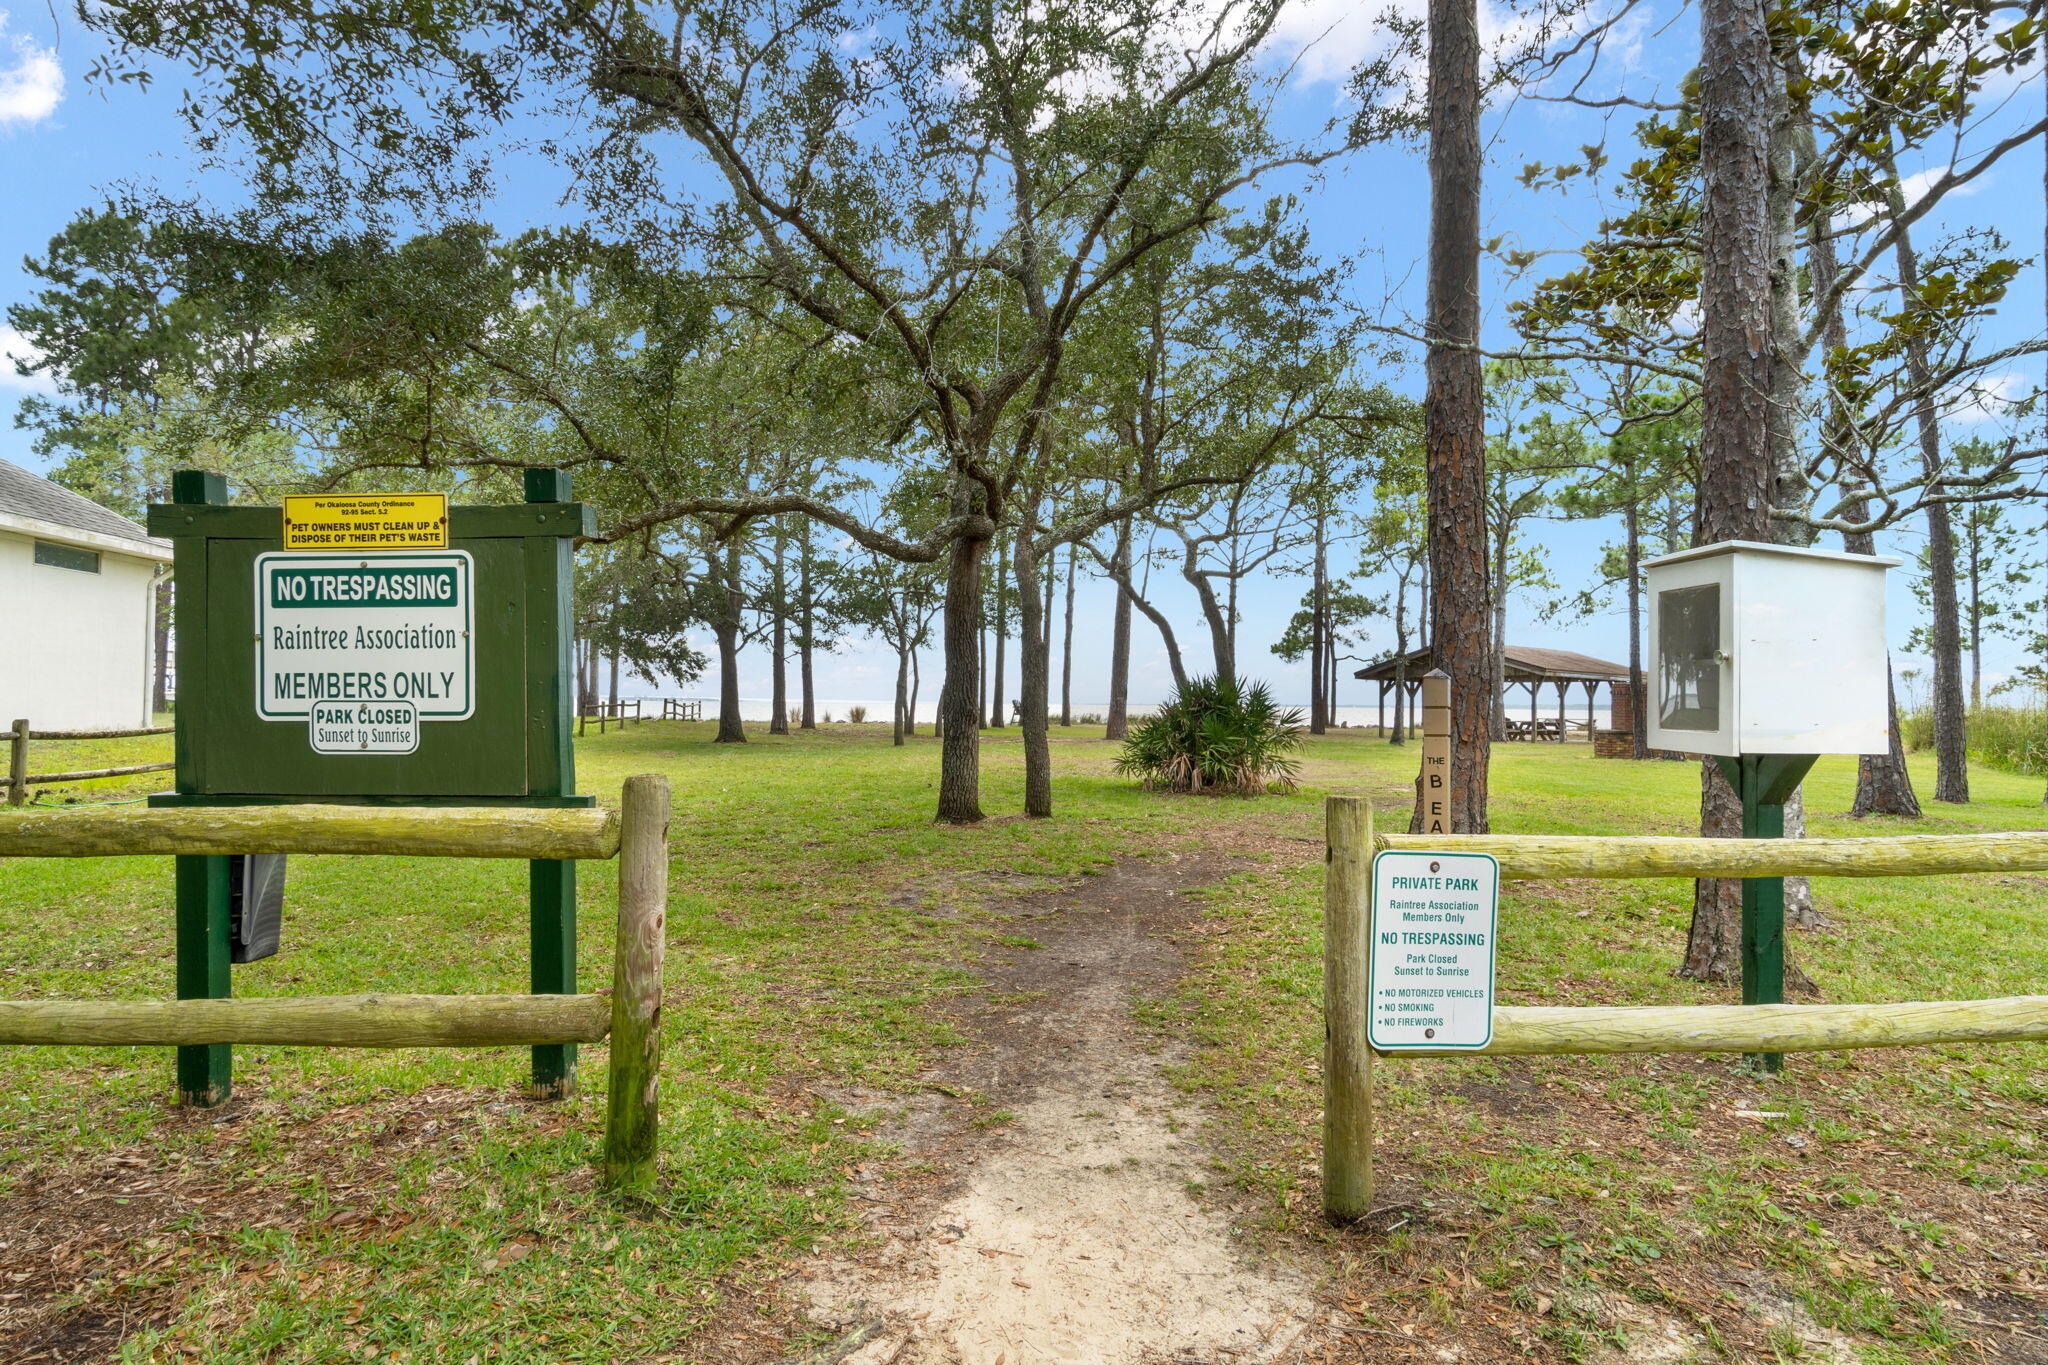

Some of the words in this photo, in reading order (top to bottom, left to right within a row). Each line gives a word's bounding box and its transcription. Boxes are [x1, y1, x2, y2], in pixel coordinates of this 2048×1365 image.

[292, 524, 309, 532] PET
[312, 523, 351, 531] OWNERS
[354, 523, 380, 531] MUST
[383, 522, 414, 530] CLEAN
[417, 522, 430, 530] UP
[433, 522, 440, 530] &
[292, 535, 331, 543] DISPOSE
[349, 534, 377, 542] THEIR
[380, 534, 406, 542] PET'S
[408, 533, 440, 541] WASTE
[277, 576, 307, 601] NO
[310, 574, 451, 600] TRESPASSING
[274, 624, 348, 650] Raintree
[355, 623, 456, 649] Association
[275, 672, 387, 699] MEMBERS
[393, 672, 454, 699] ONLY
[317, 709, 353, 724] PARK
[358, 710, 411, 724] CLOSED
[319, 728, 354, 743] Sunset
[358, 729, 368, 743] to
[372, 728, 411, 743] Sunrise
[1427, 757, 1445, 765] THE
[1392, 877, 1441, 889] PRIVATE
[1446, 878, 1478, 891] PARK
[1390, 900, 1426, 909] Raintree
[1429, 901, 1479, 911] Association
[1403, 913, 1442, 922] Members
[1445, 913, 1465, 924] Only
[1381, 932, 1398, 944] NO
[1402, 933, 1485, 945] TRESPASSING
[1407, 954, 1426, 963] Park
[1428, 954, 1458, 964] Closed
[1395, 967, 1423, 976] Sunset
[1426, 968, 1434, 976] to
[1437, 967, 1469, 976] Sunrise
[1385, 989, 1396, 997] NO
[1398, 989, 1444, 998] MOTORIZED
[1447, 990, 1484, 998] VEHICLES
[1385, 1004, 1395, 1012] NO
[1398, 1004, 1434, 1012] SMOKING
[1384, 1018, 1395, 1026] NO
[1398, 1018, 1444, 1026] FIREWORKS
